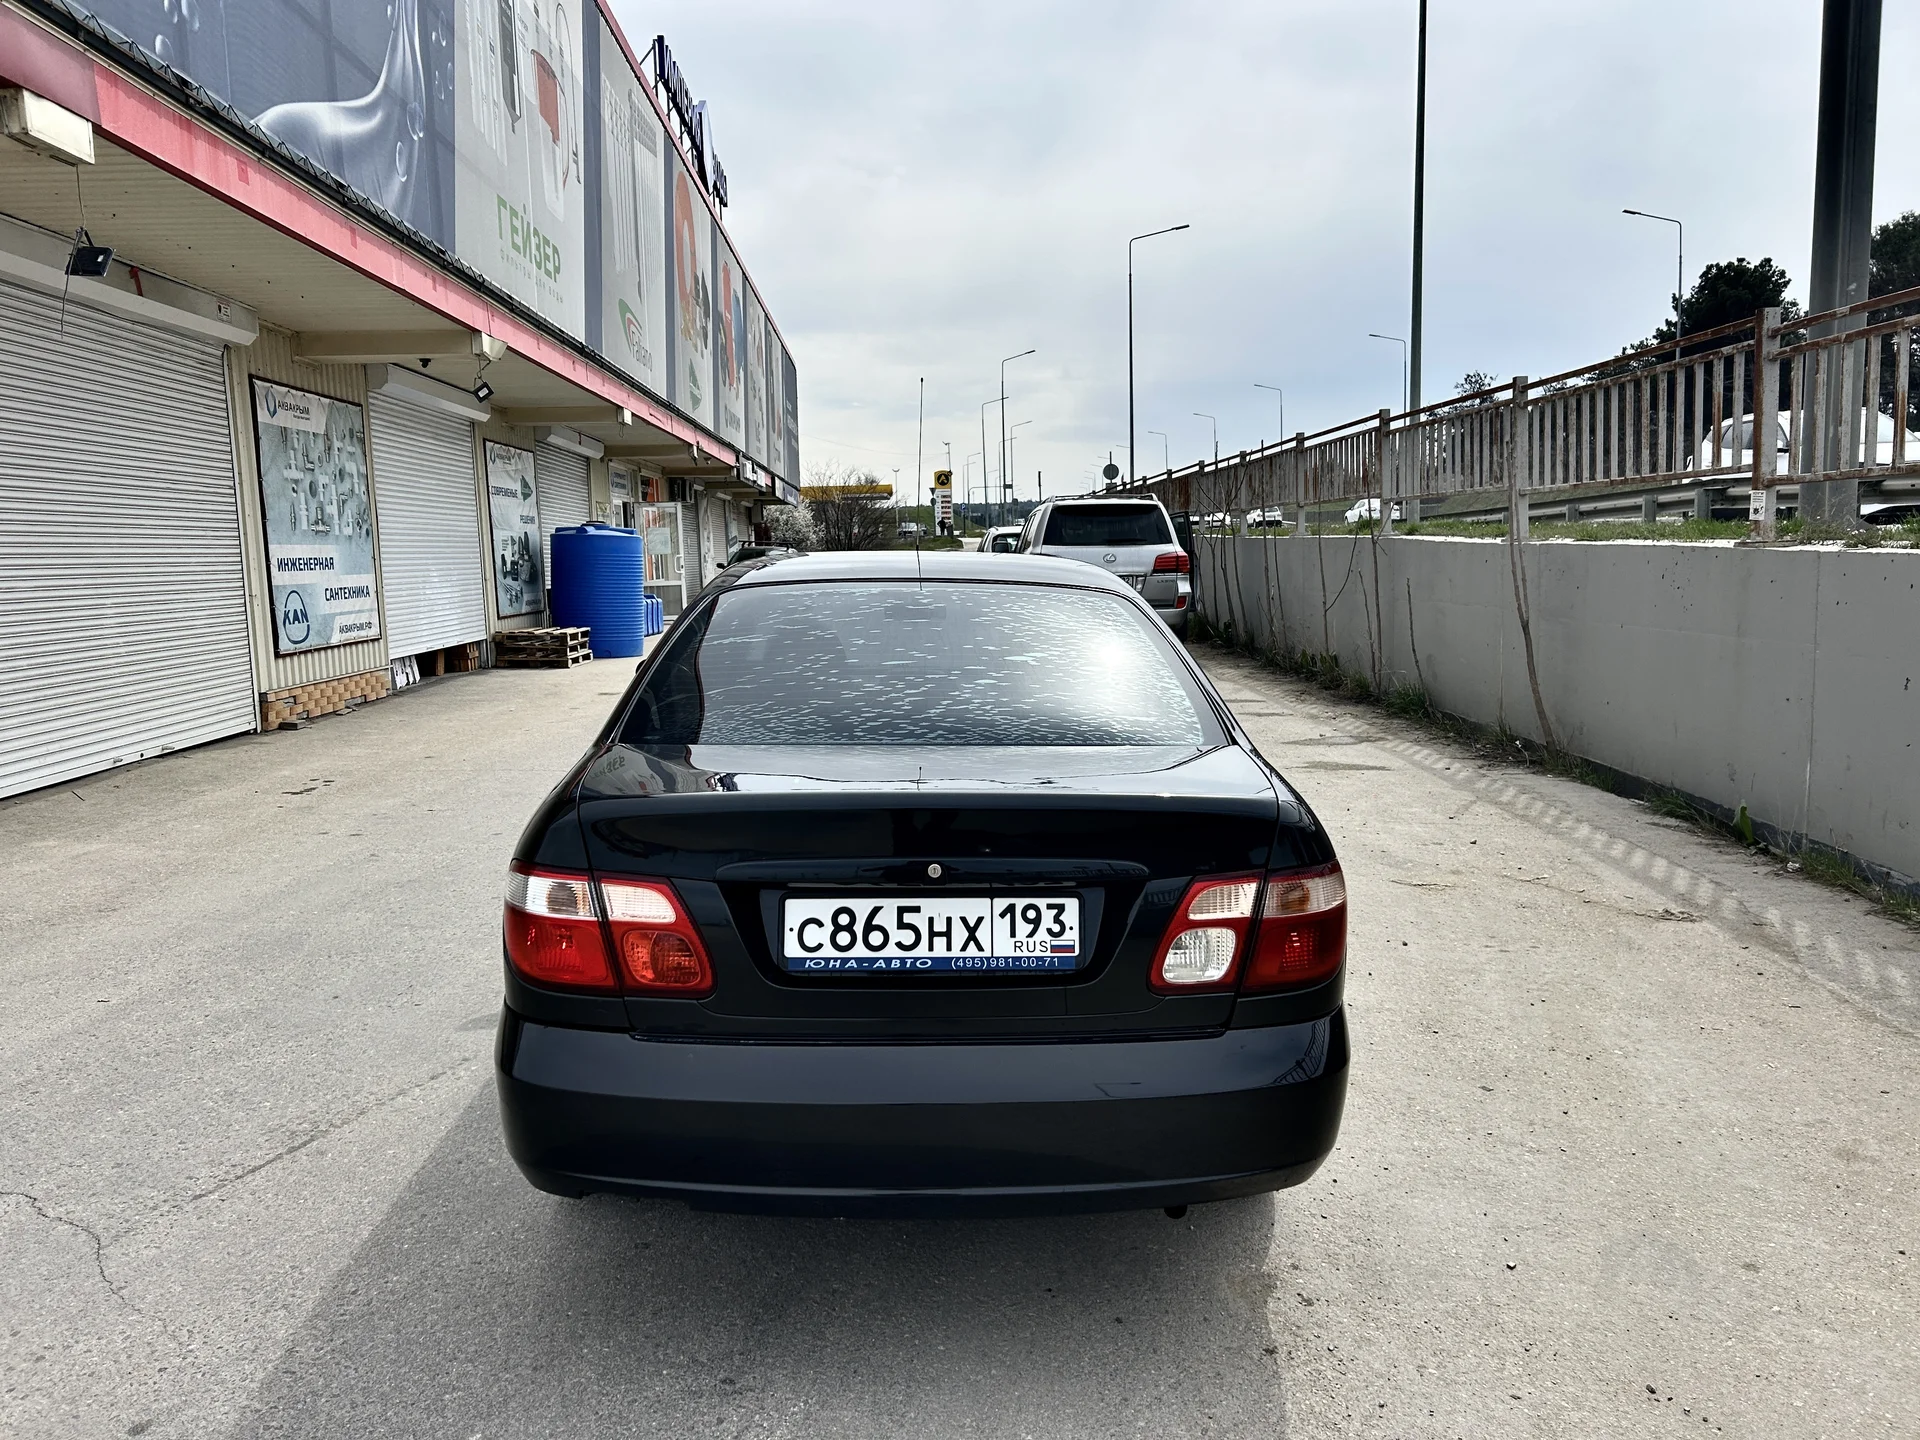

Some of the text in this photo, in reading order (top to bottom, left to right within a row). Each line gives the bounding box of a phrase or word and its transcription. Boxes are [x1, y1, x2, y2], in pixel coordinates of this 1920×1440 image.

[496, 193, 561, 283] ГЕЙЗЕР
[277, 400, 311, 416] АКВАКРЫМ
[276, 556, 335, 573] ИНЖЕНЕРНАЯ
[324, 585, 371, 602] САНТЕХНИКА
[283, 608, 310, 626] KAN
[338, 620, 373, 635] АКВАКРЫМ.РФ
[998, 902, 1067, 939] 193
[1013, 940, 1049, 953] RUS
[804, 958, 933, 969] ЮНА-АВТО
